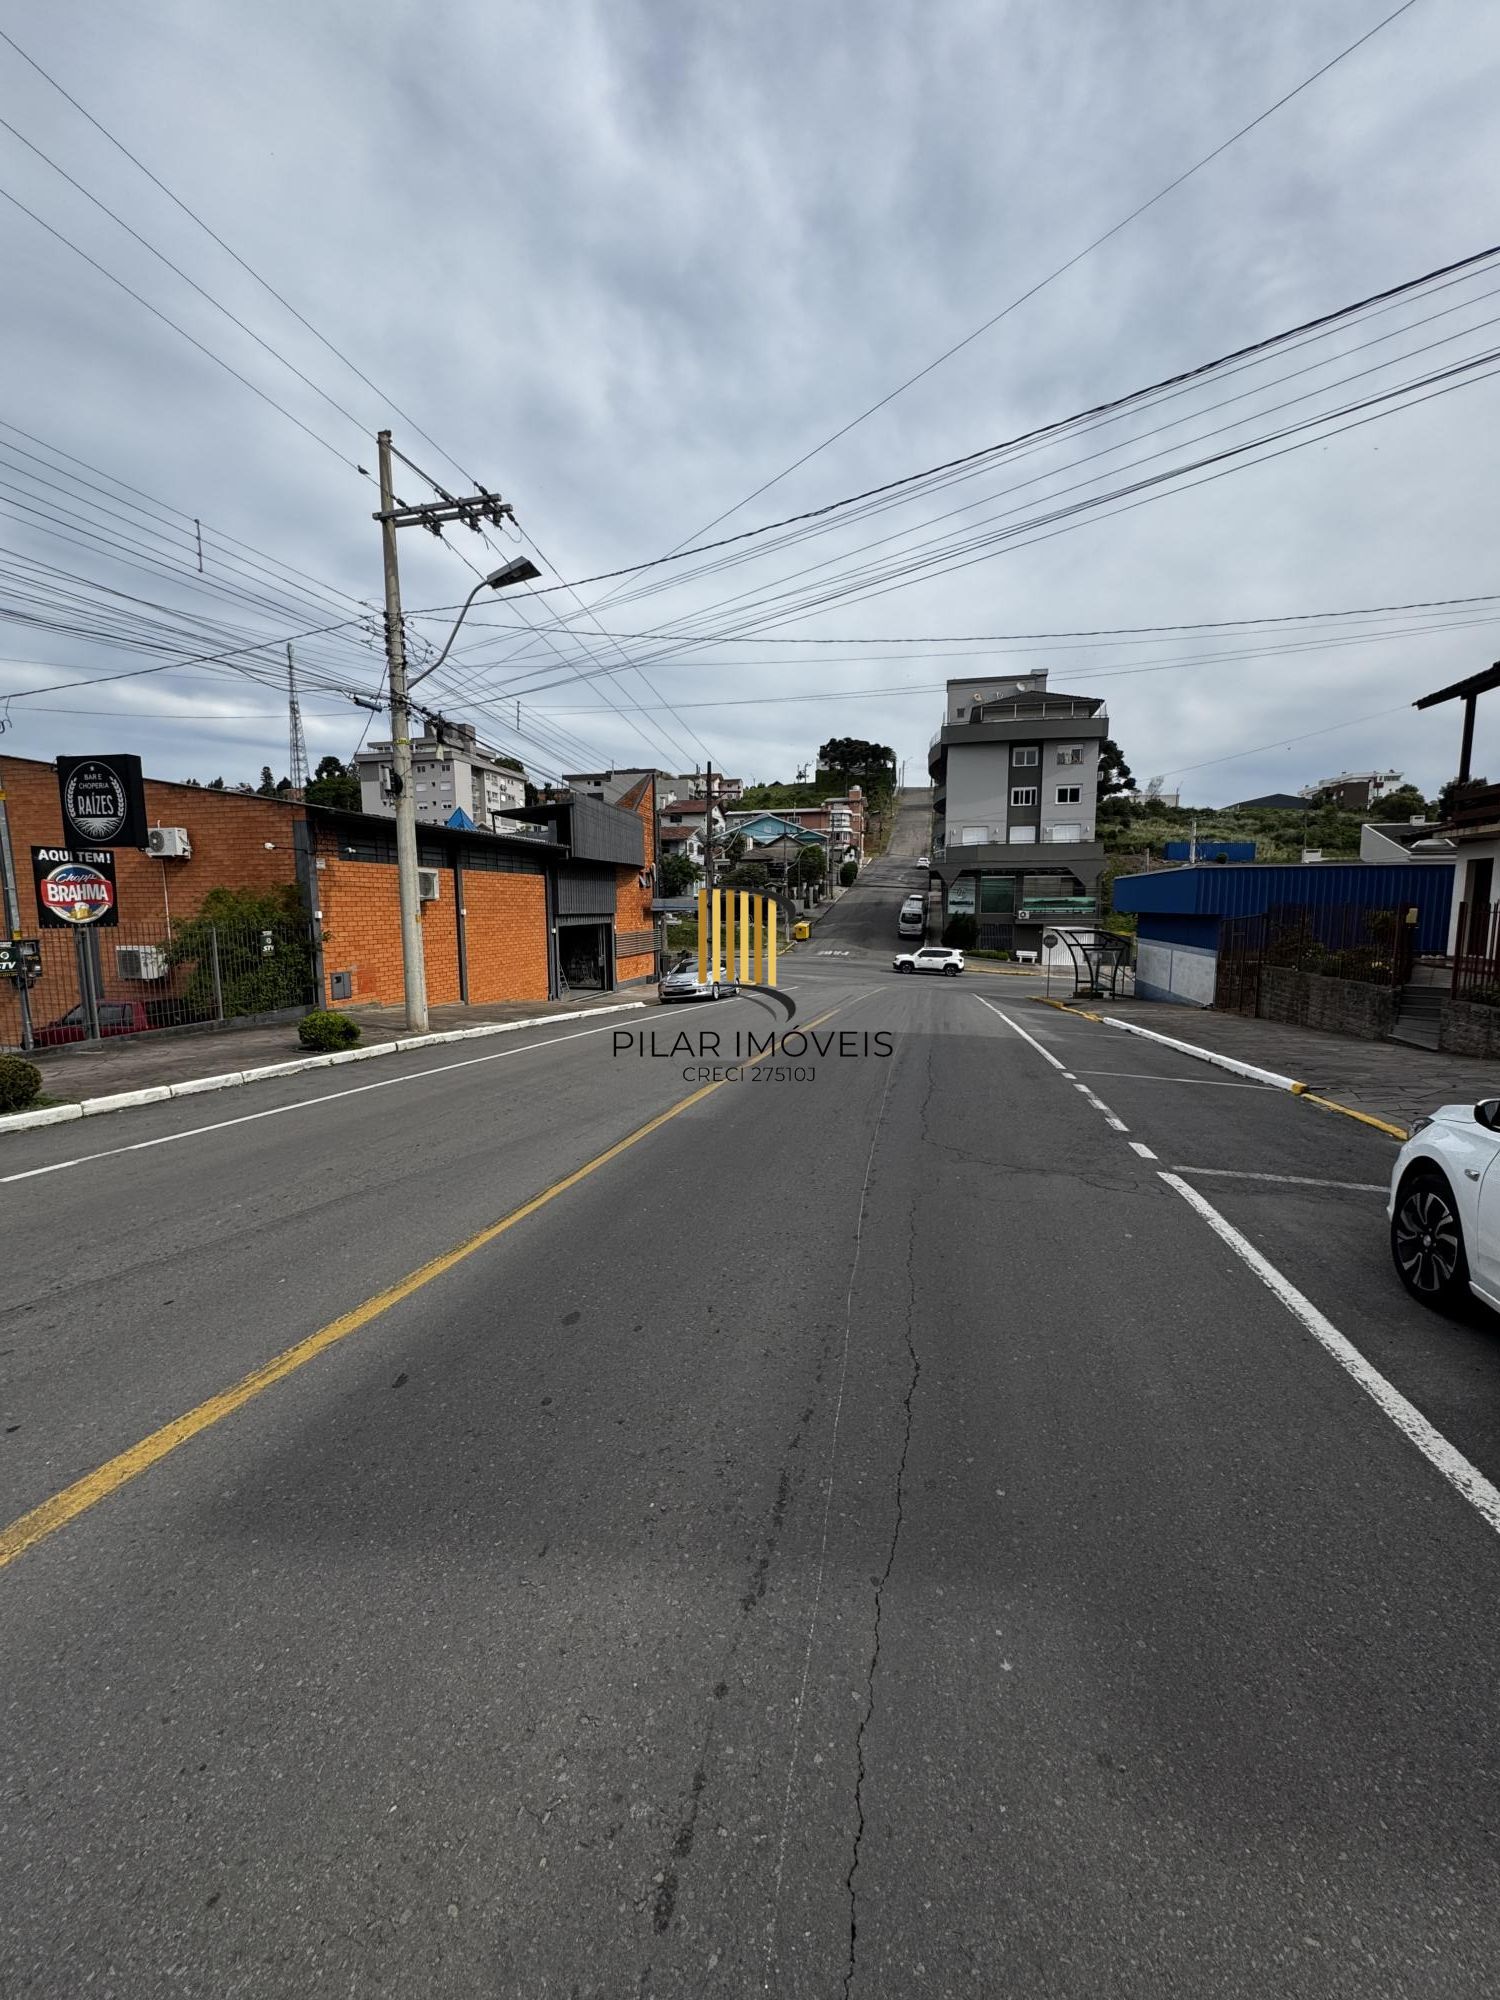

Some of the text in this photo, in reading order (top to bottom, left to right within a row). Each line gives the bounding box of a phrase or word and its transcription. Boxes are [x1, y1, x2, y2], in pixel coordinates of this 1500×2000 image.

[78, 792, 114, 815] RAÍZES
[38, 849, 111, 864] AQUI TEM!
[47, 883, 109, 902] BRAHMA
